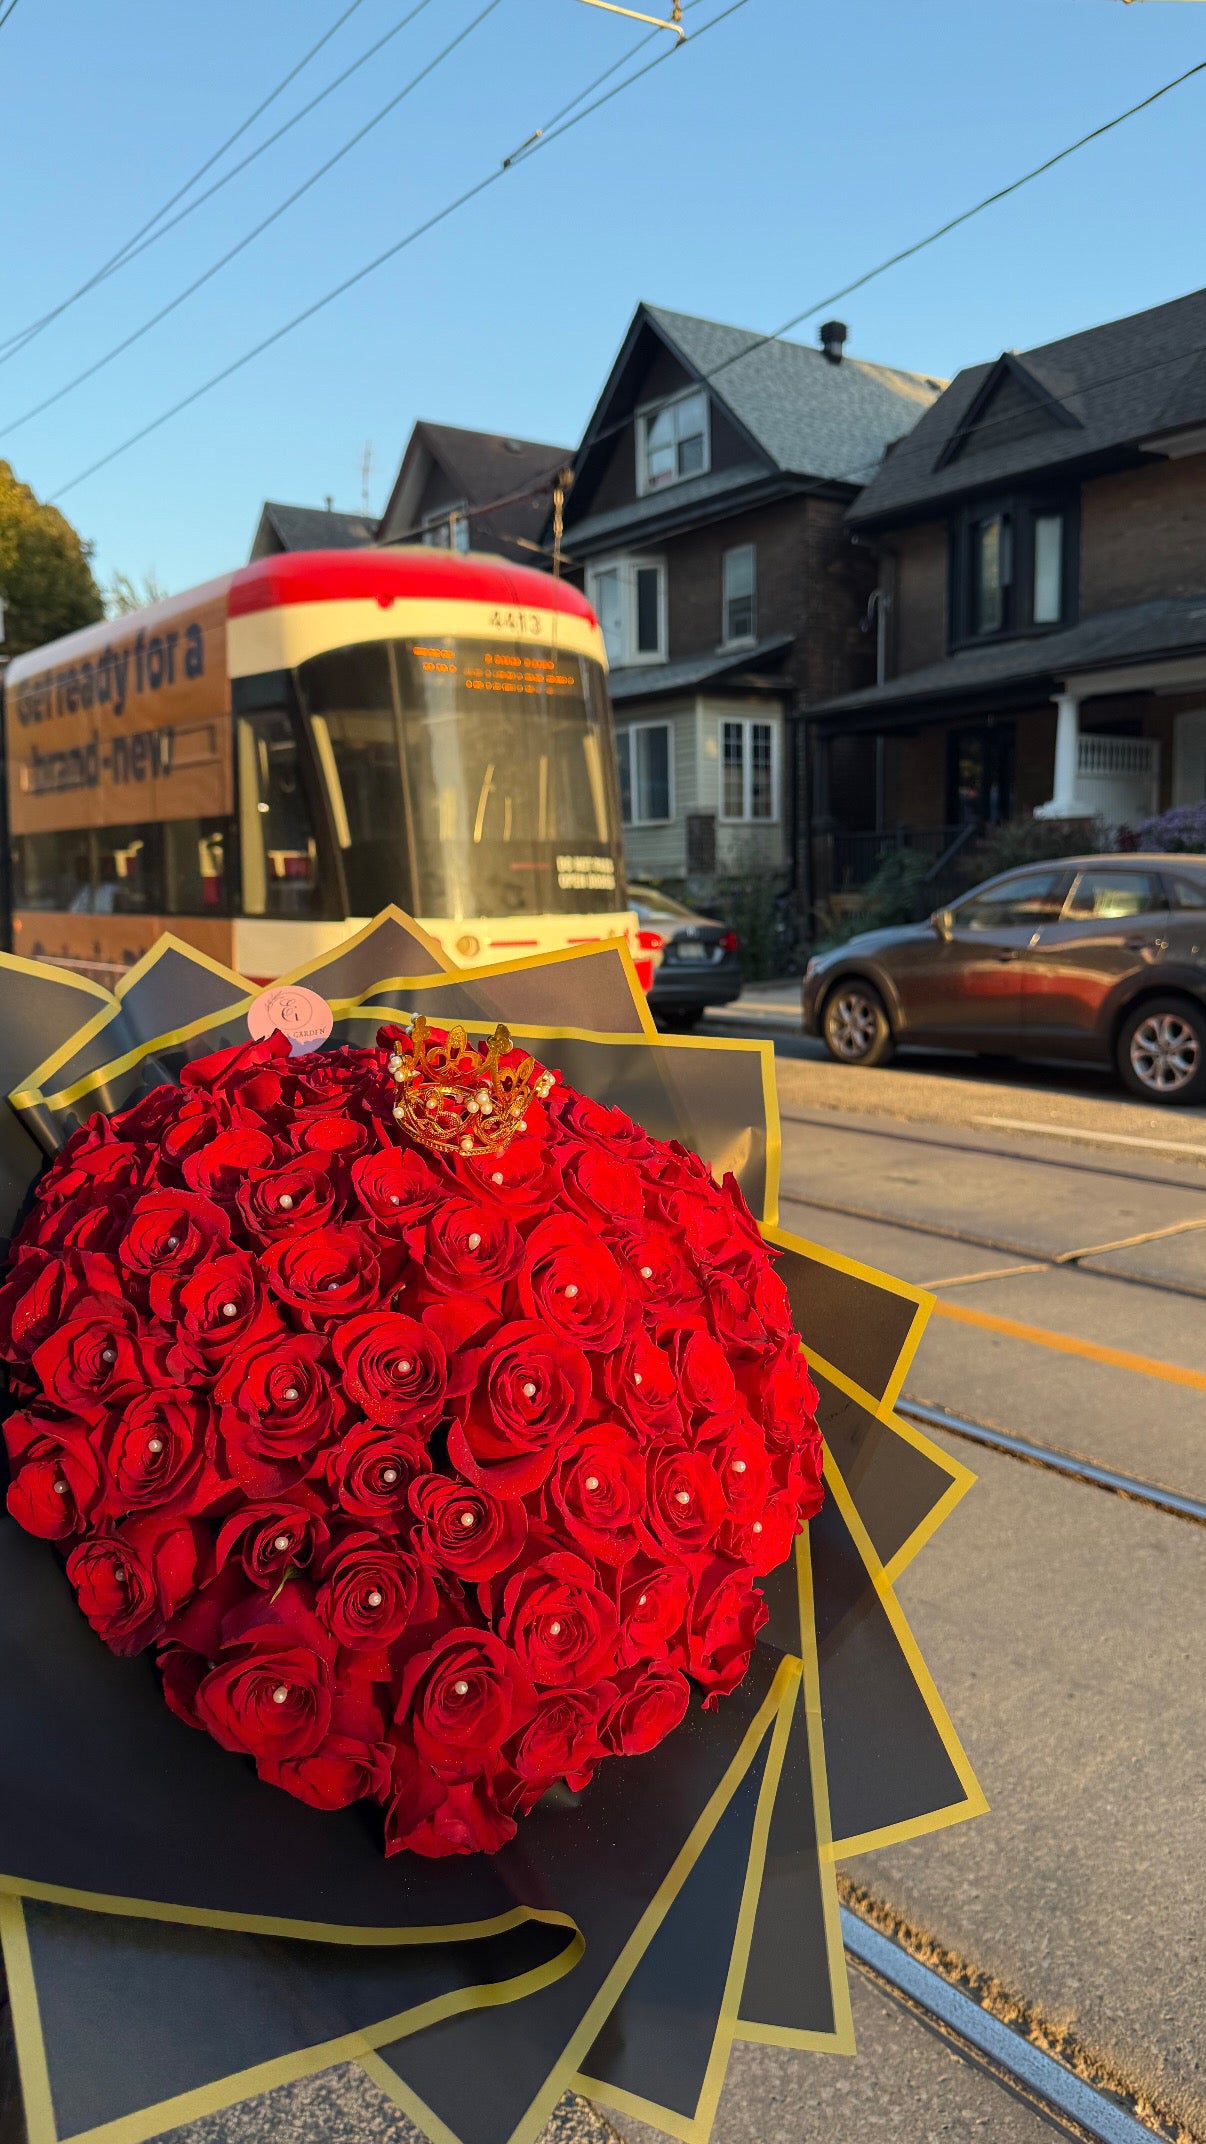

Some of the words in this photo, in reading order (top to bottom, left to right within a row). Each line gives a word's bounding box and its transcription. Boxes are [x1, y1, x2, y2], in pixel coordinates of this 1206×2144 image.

[56, 643, 129, 716] ready
[134, 626, 178, 694] for
[185, 623, 204, 679] a
[293, 1027, 325, 1039] GARDEN
